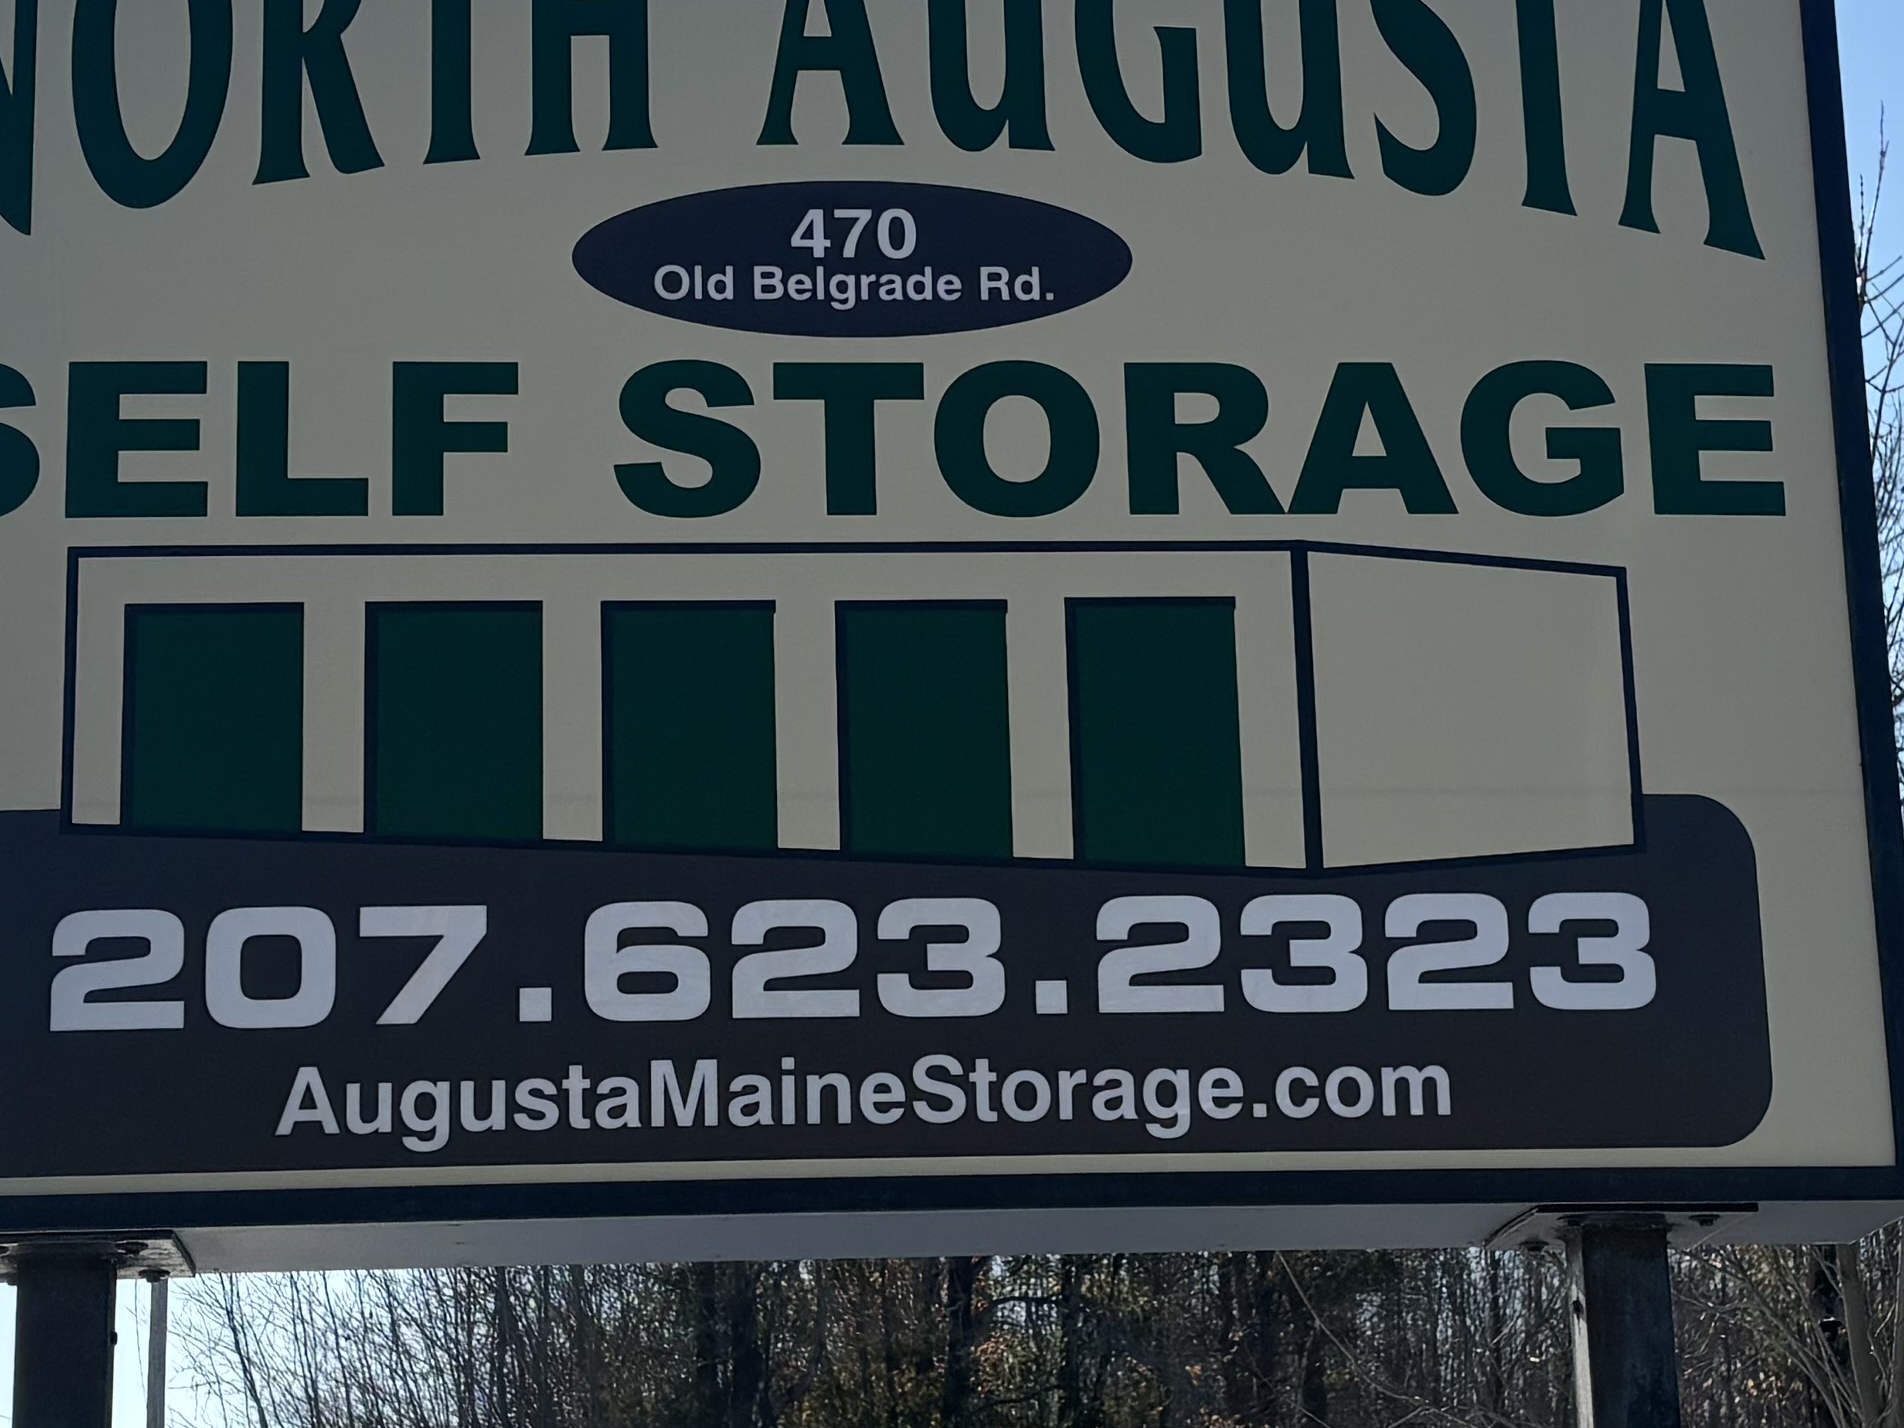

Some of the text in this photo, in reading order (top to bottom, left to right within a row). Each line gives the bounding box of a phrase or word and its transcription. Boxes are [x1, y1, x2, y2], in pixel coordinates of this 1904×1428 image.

[790, 208, 917, 260] 470
[653, 264, 1055, 311] Old Belgrade Rd.
[613, 359, 1787, 519] STORAGE
[49, 892, 1657, 1032] 207.623.2323
[275, 1054, 1453, 1154] AugustaMaineStorage.com
